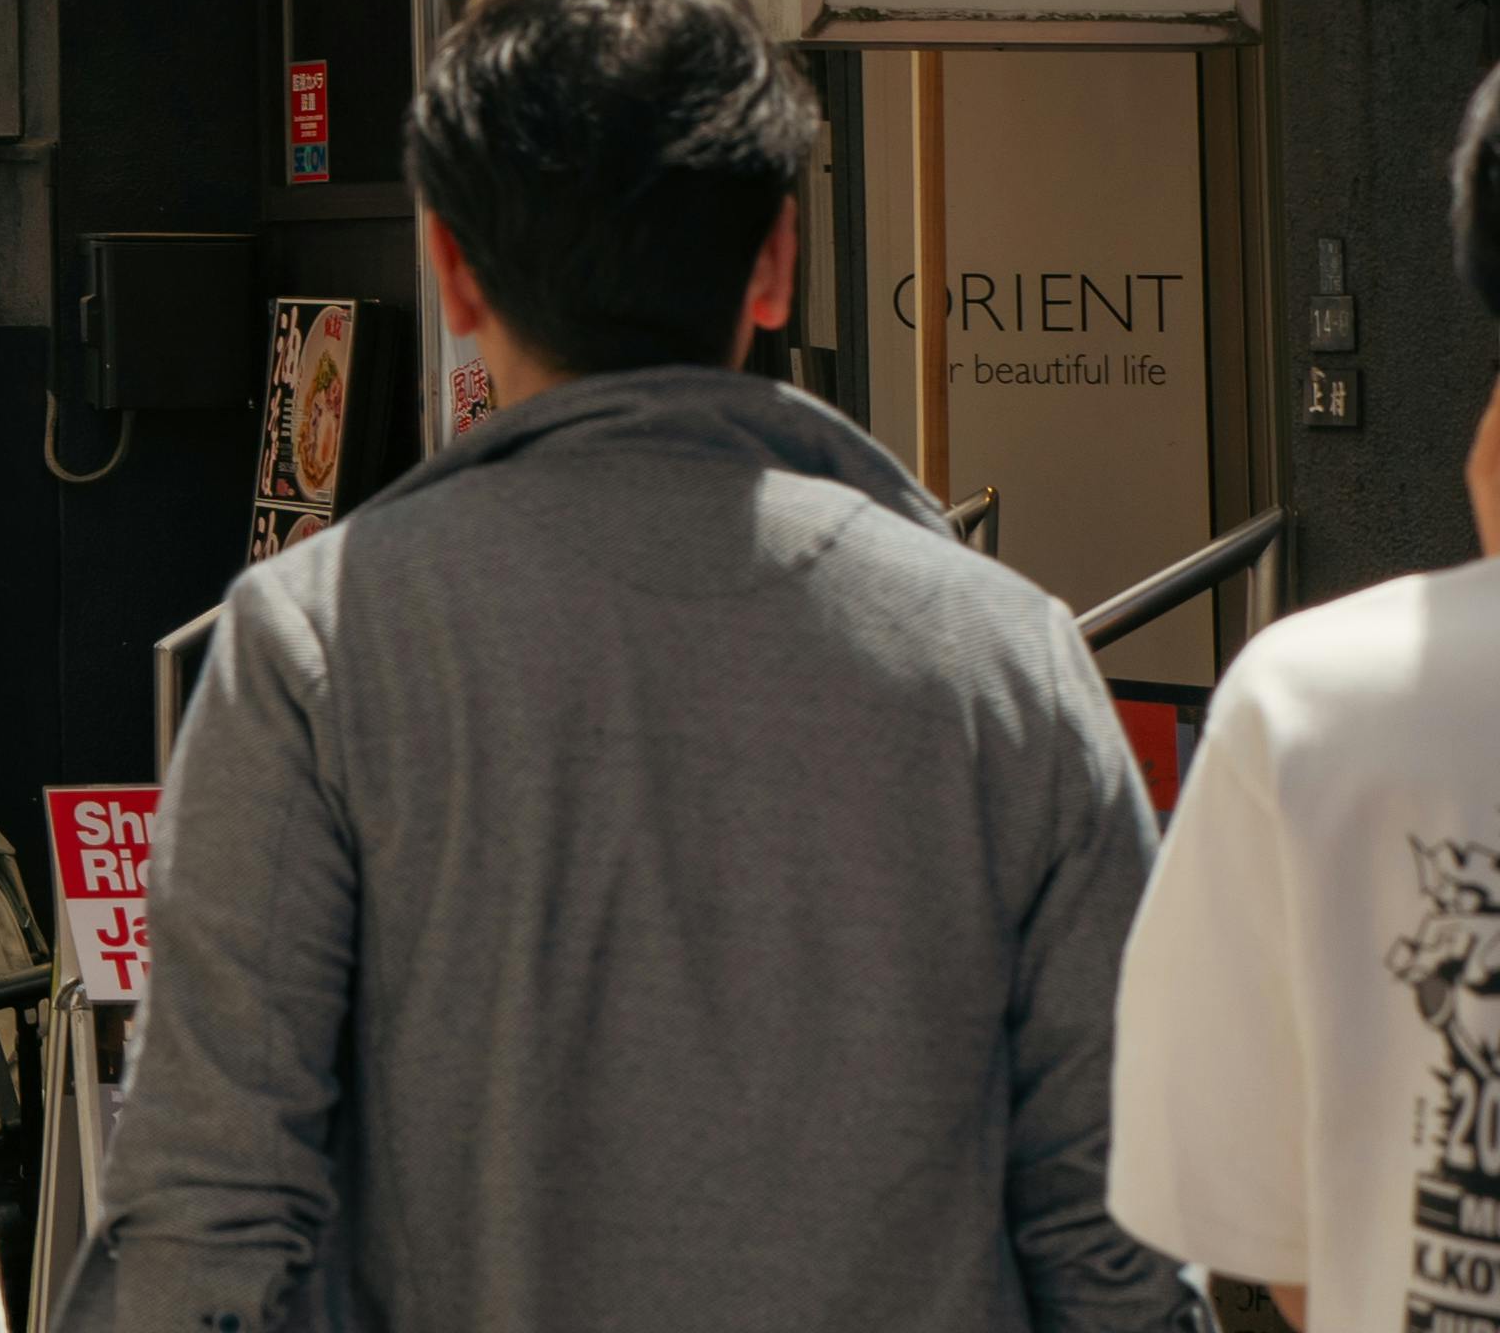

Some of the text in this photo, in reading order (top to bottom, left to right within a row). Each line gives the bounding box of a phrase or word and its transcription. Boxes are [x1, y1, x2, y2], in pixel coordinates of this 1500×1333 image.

[975, 353, 1110, 386] beautiful
[1124, 354, 1167, 386] life
[101, 949, 151, 991] T
